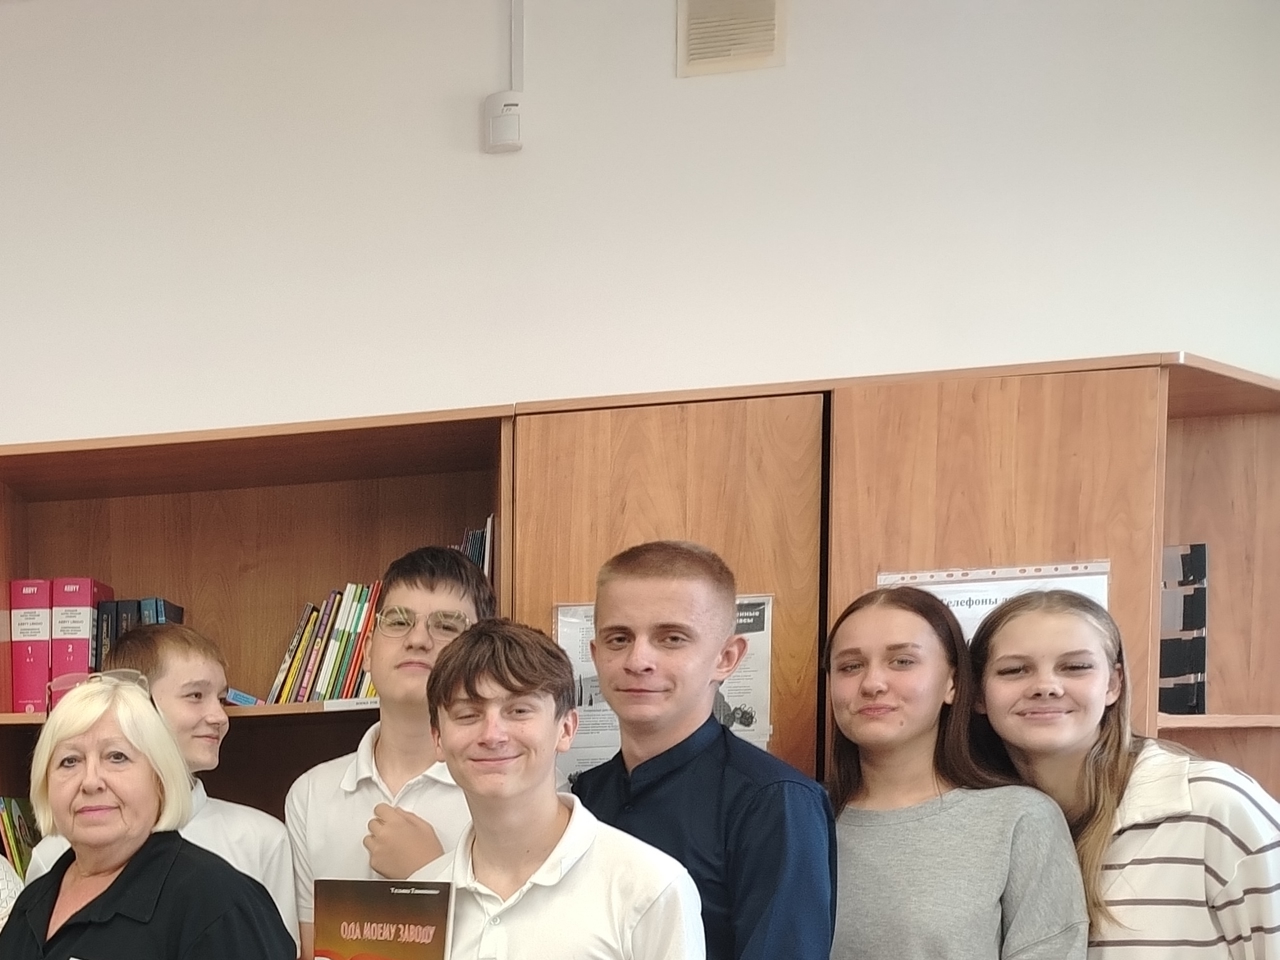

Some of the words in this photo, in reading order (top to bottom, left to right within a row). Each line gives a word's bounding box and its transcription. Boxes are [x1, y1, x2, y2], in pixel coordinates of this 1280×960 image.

[67, 644, 73, 653] 2
[340, 921, 361, 941] ОДА
[363, 921, 397, 941] МОЕМУ
[397, 923, 437, 944] ЗАВОДУ
